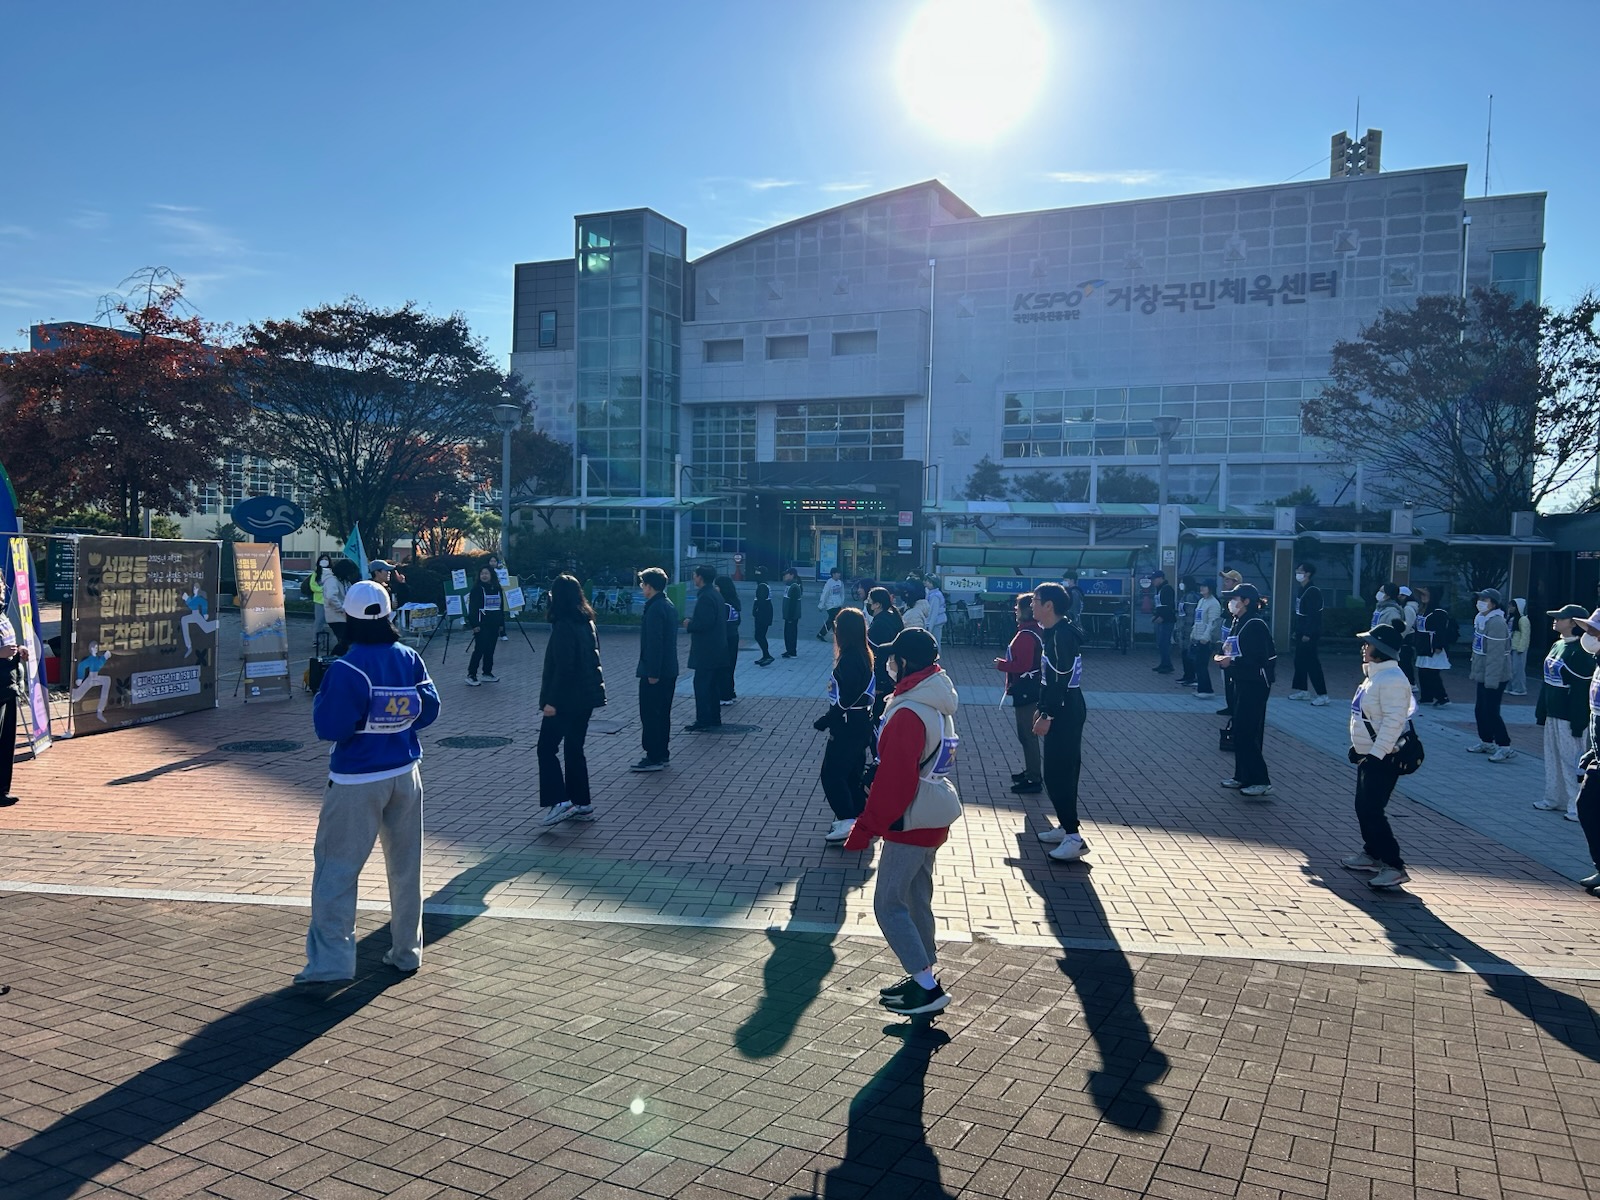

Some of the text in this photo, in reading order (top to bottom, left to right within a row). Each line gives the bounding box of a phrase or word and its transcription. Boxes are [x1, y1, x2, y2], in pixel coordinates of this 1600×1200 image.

[1013, 291, 1083, 311] KSPO
[1106, 270, 1338, 315] 거창국민체육센터
[1013, 309, 1080, 324] 국민체육진흥공단
[102, 555, 148, 584] 성평등
[236, 558, 257, 569] 성평등
[100, 588, 178, 618] 함께 걸어야
[98, 619, 177, 651] 도착합니다.
[385, 697, 410, 716] 42
